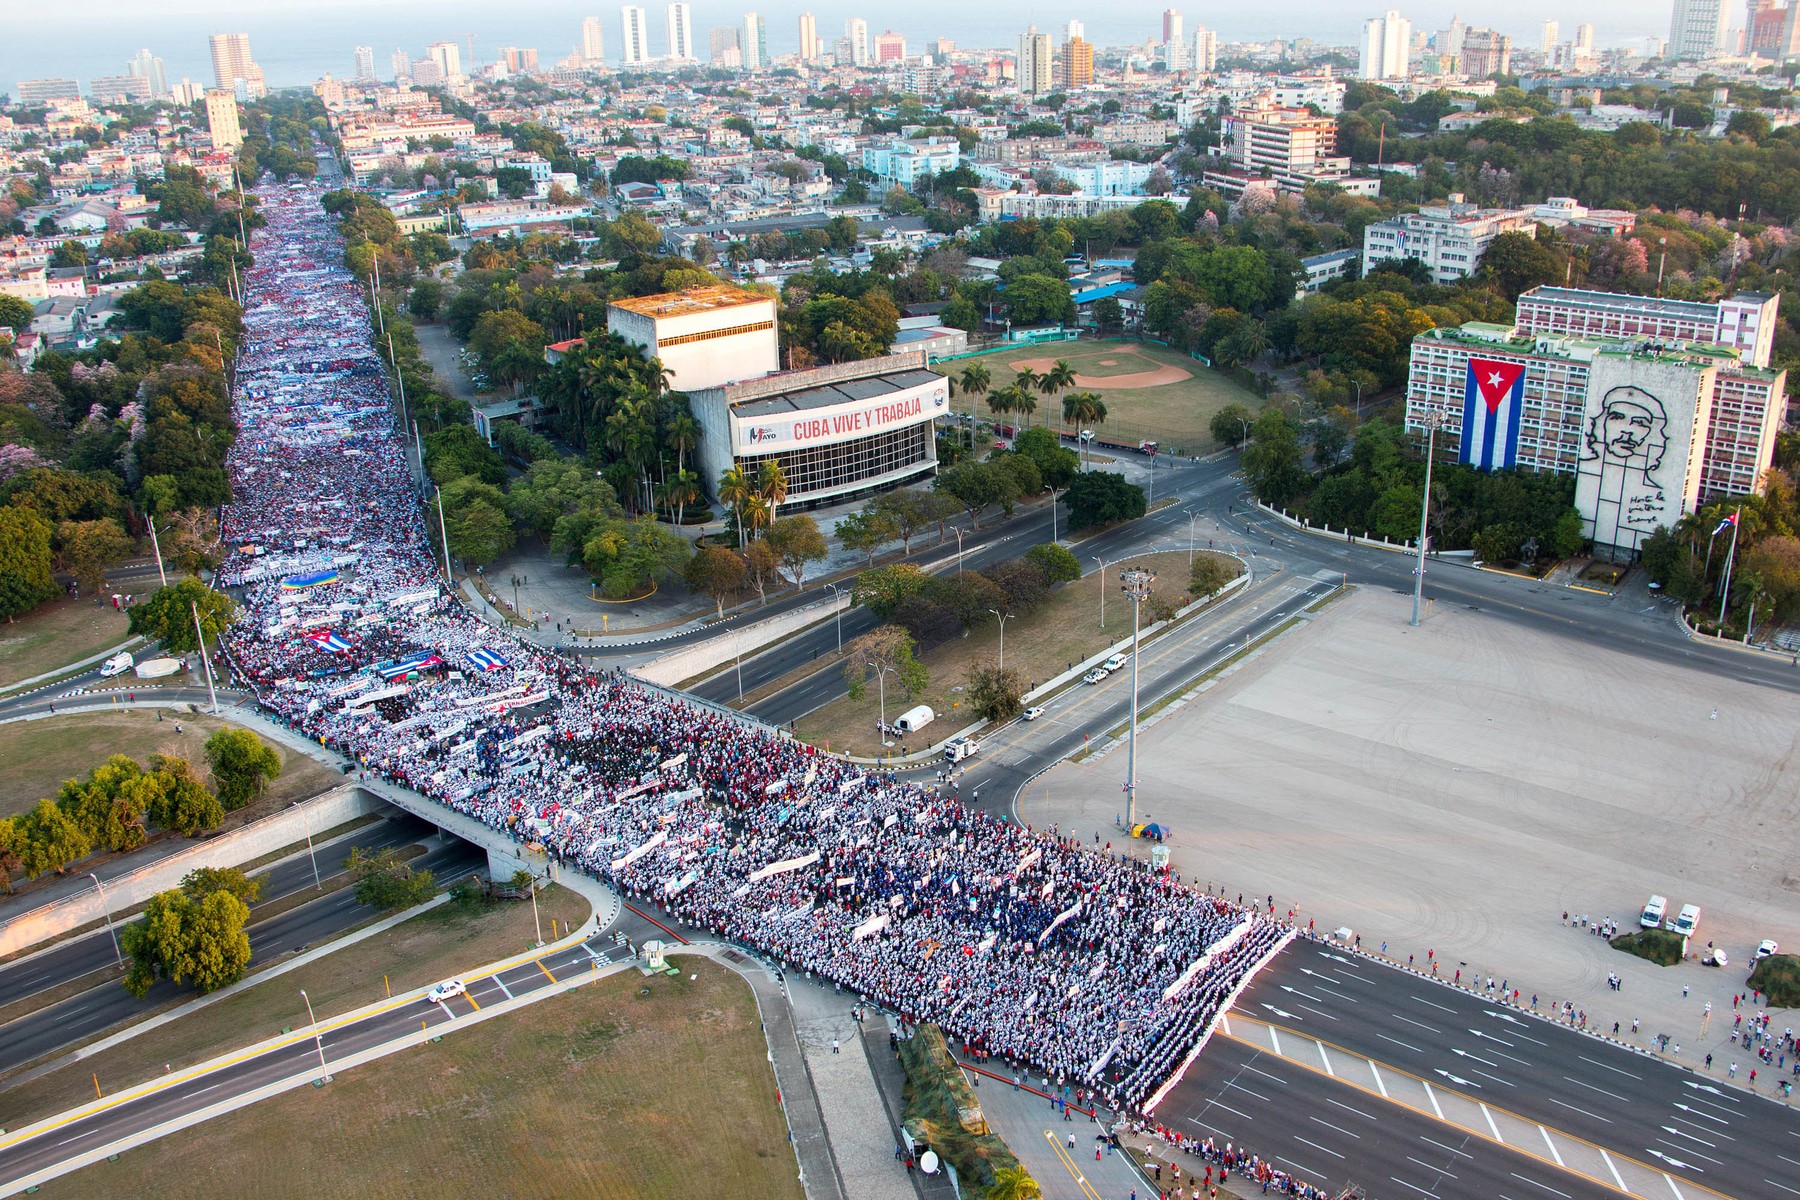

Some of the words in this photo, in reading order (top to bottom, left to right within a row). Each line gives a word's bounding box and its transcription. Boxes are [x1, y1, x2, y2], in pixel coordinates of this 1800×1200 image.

[794, 418, 830, 440] CUBA
[833, 412, 862, 434] VIVE
[864, 409, 872, 428] Y
[874, 397, 922, 425] TRABAJA
